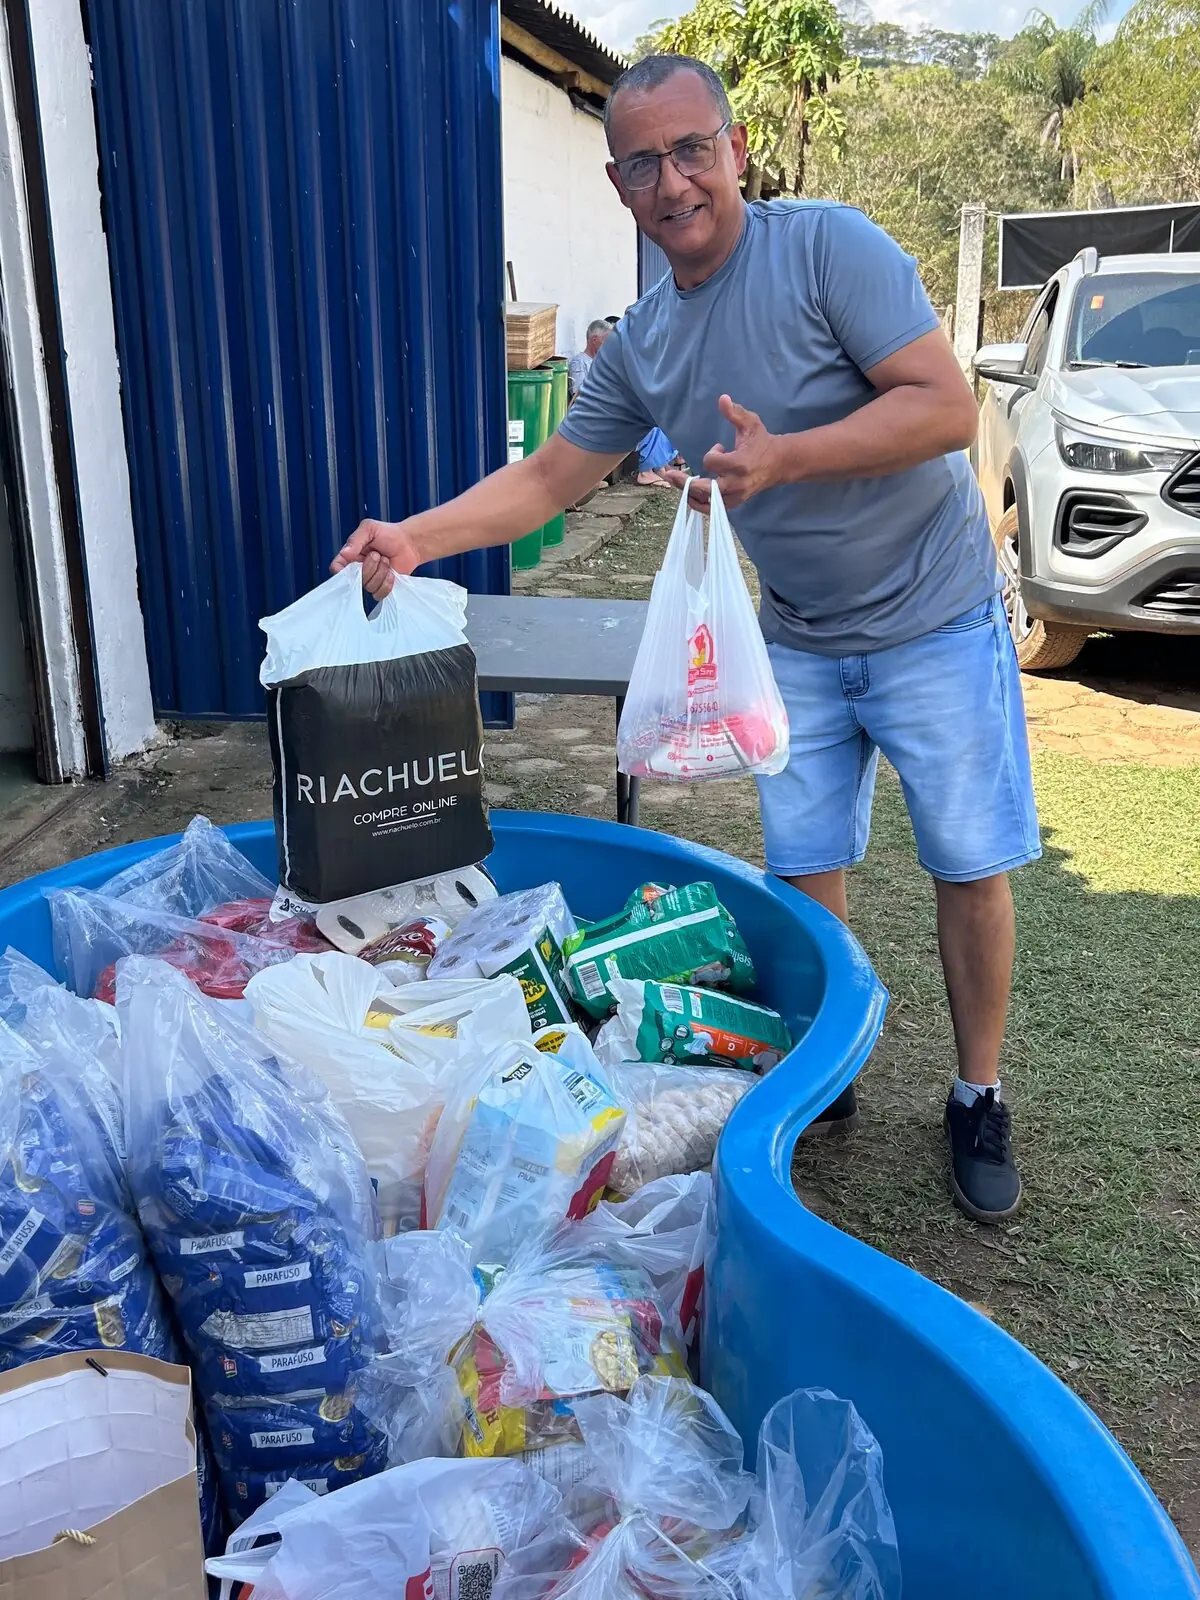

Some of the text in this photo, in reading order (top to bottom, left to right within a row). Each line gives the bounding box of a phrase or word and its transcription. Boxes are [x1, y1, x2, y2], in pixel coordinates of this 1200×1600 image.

[353, 795, 458, 826] COMPRE ONLINE
[371, 817, 442, 837] www.riachuelo.com.br
[523, 985, 543, 1000] PLAS
[727, 1042, 736, 1051] G
[190, 1235, 233, 1250] PARAFUSO
[256, 1267, 301, 1284] PARAFUSO
[271, 1352, 314, 1368] PARAFUSO
[260, 1432, 303, 1445] PARAFUSO
